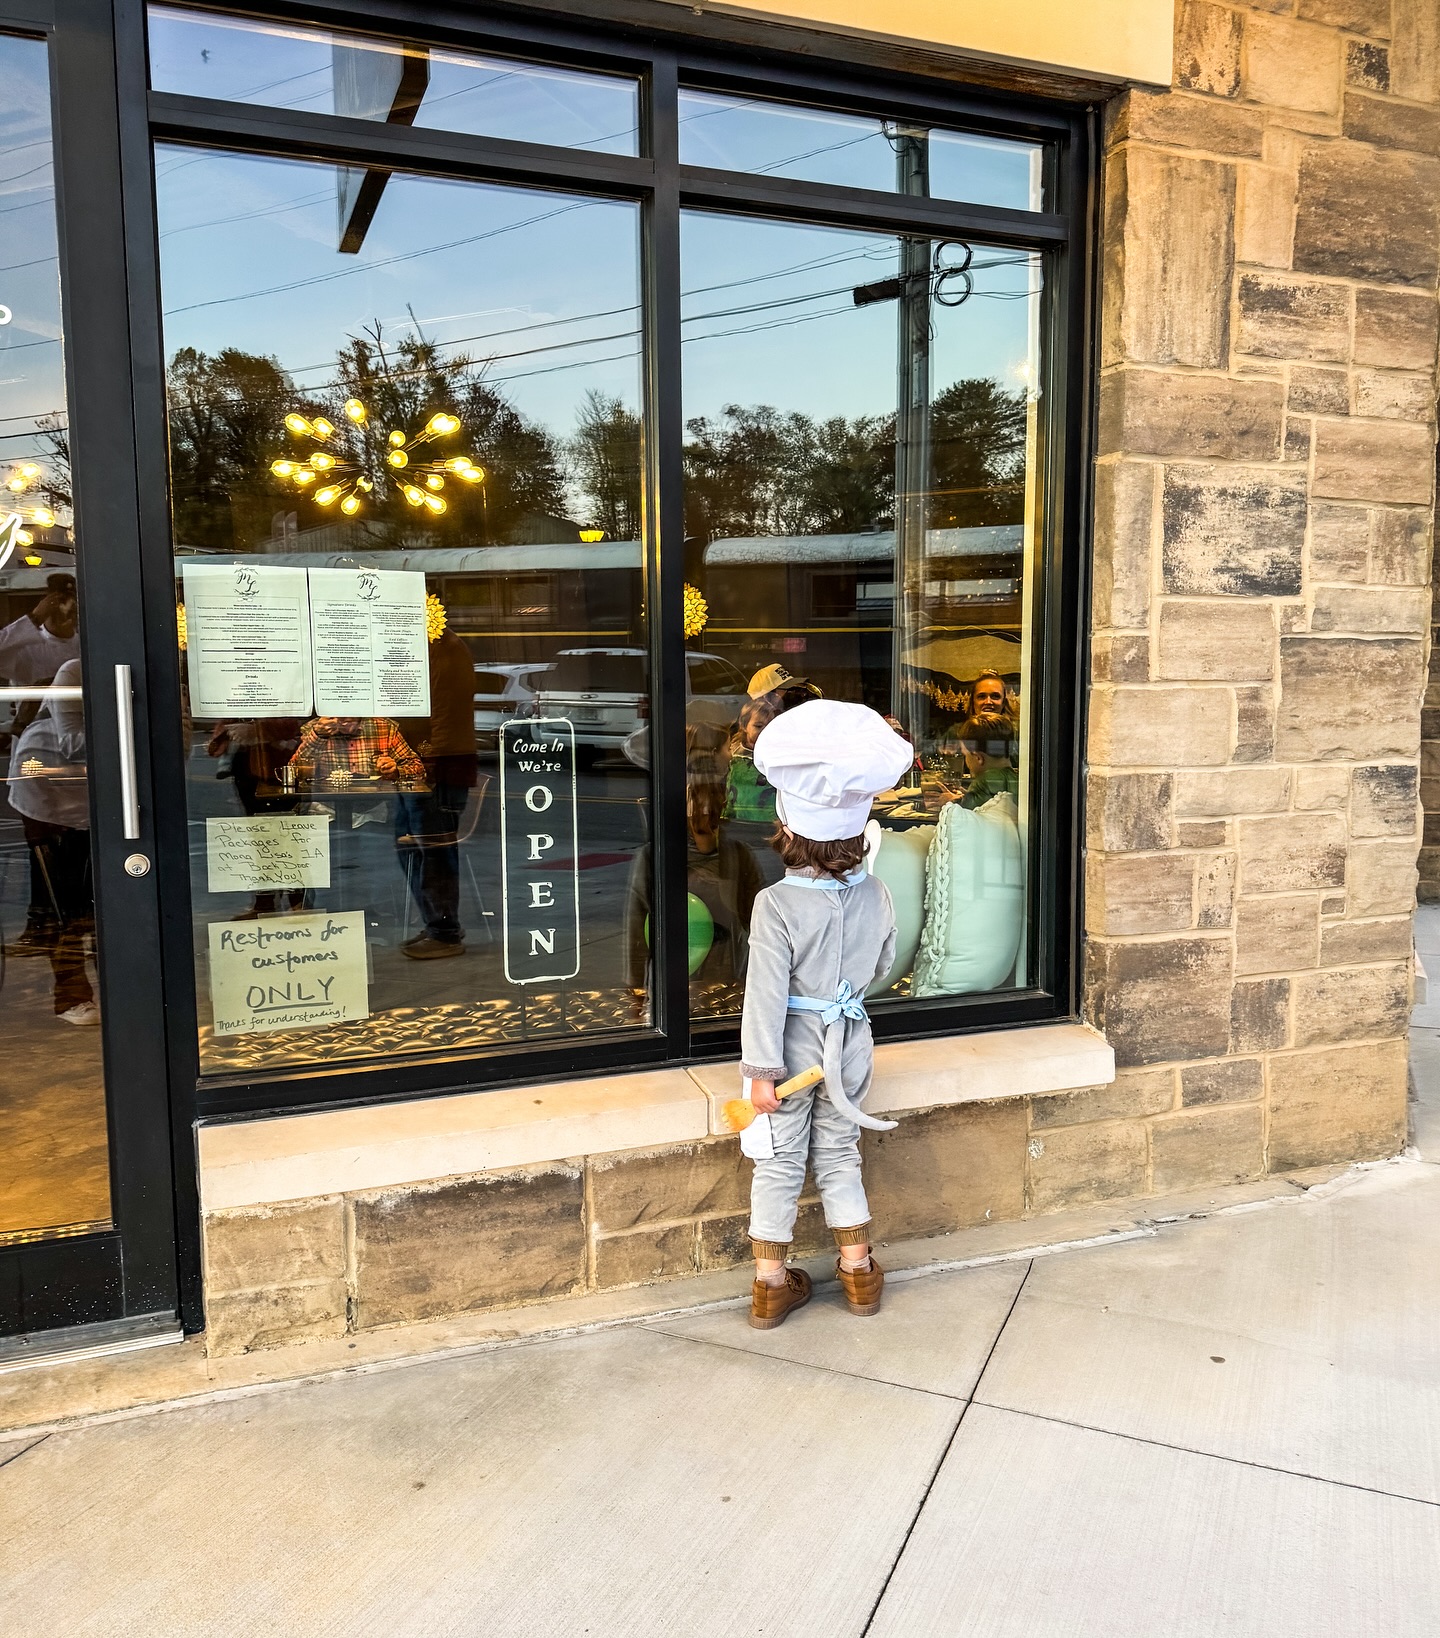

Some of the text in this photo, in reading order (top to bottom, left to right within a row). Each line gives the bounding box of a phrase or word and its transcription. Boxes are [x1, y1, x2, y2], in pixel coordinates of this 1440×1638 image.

[512, 737, 564, 753] Come In
[518, 760, 562, 773] We're
[219, 821, 316, 834] Please Leave
[215, 833, 311, 853] Packages for
[218, 853, 253, 861] Mona
[259, 849, 293, 859] Lisa's
[217, 861, 310, 872] at Back Door
[525, 785, 556, 956] OPEN
[230, 870, 303, 883] Thank You!
[220, 920, 348, 953] Restrooms for
[251, 949, 339, 973] customers
[245, 975, 335, 1009] ONLY
[216, 1005, 347, 1031] Thanks for understanding!
